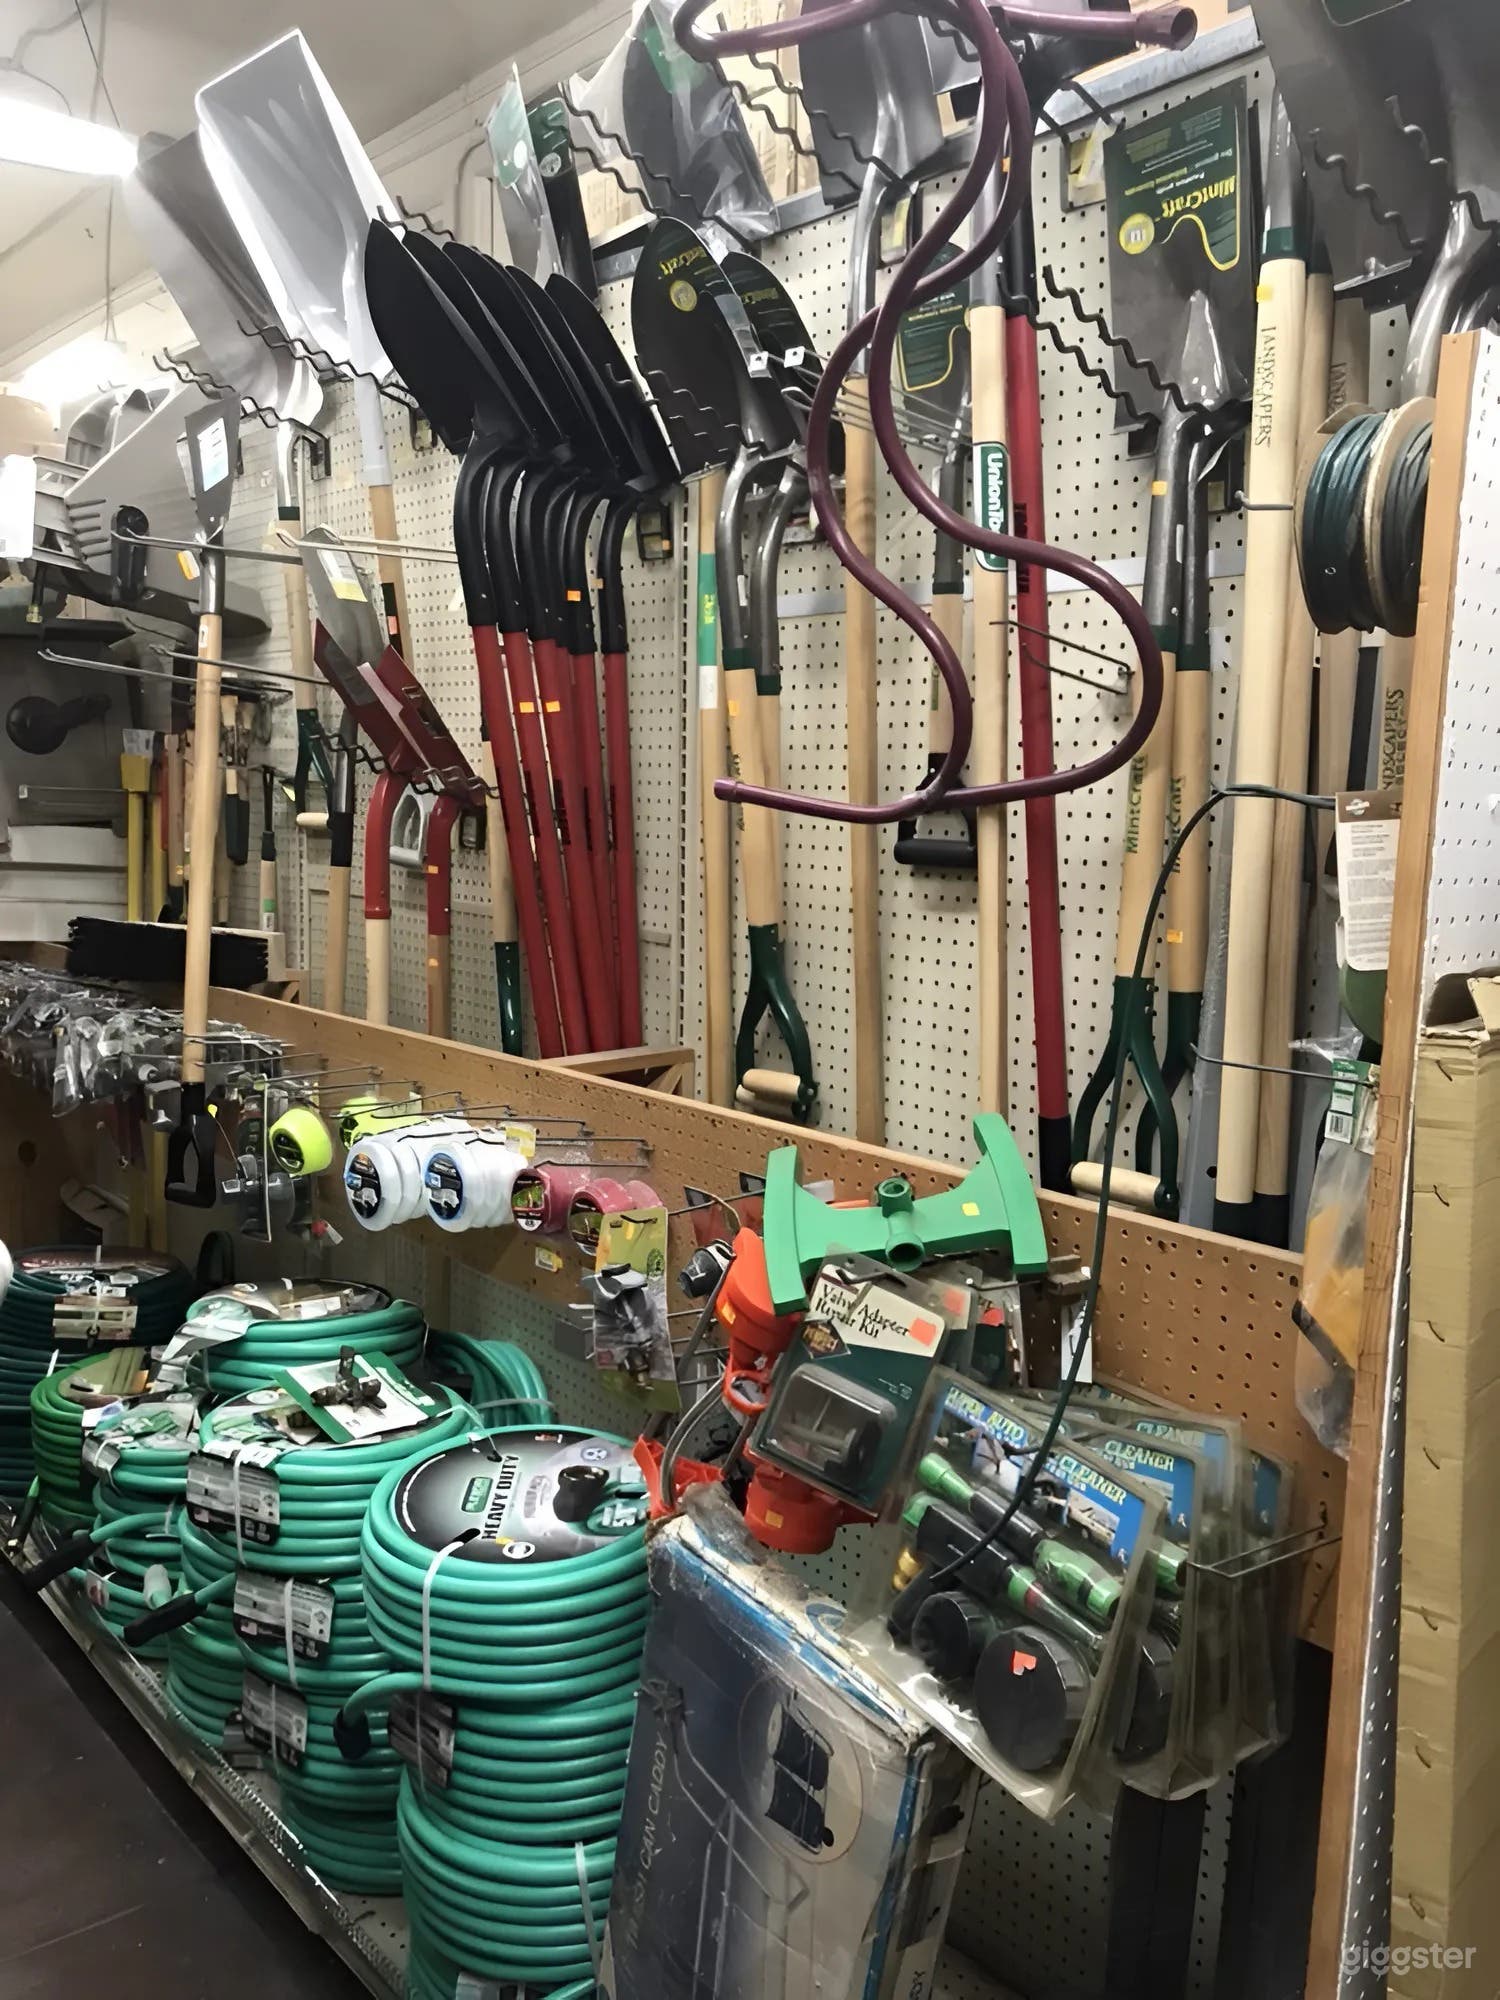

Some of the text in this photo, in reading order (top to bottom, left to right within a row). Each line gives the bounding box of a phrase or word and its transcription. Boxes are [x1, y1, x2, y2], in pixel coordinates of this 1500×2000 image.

[1254, 325, 1277, 449] LANDSCAPERS
[1125, 754, 1147, 854] MintCraft
[858, 1317, 880, 1339] Kit
[481, 1493, 508, 1540] HEAVY
[496, 1455, 520, 1490] DUTY
[986, 1410, 1026, 1445] AUTO
[1058, 1454, 1128, 1507] CLEANER
[1104, 1439, 1175, 1473] CLEANER
[647, 1730, 668, 1815] CADDY
[639, 1817, 657, 1870] CAN
